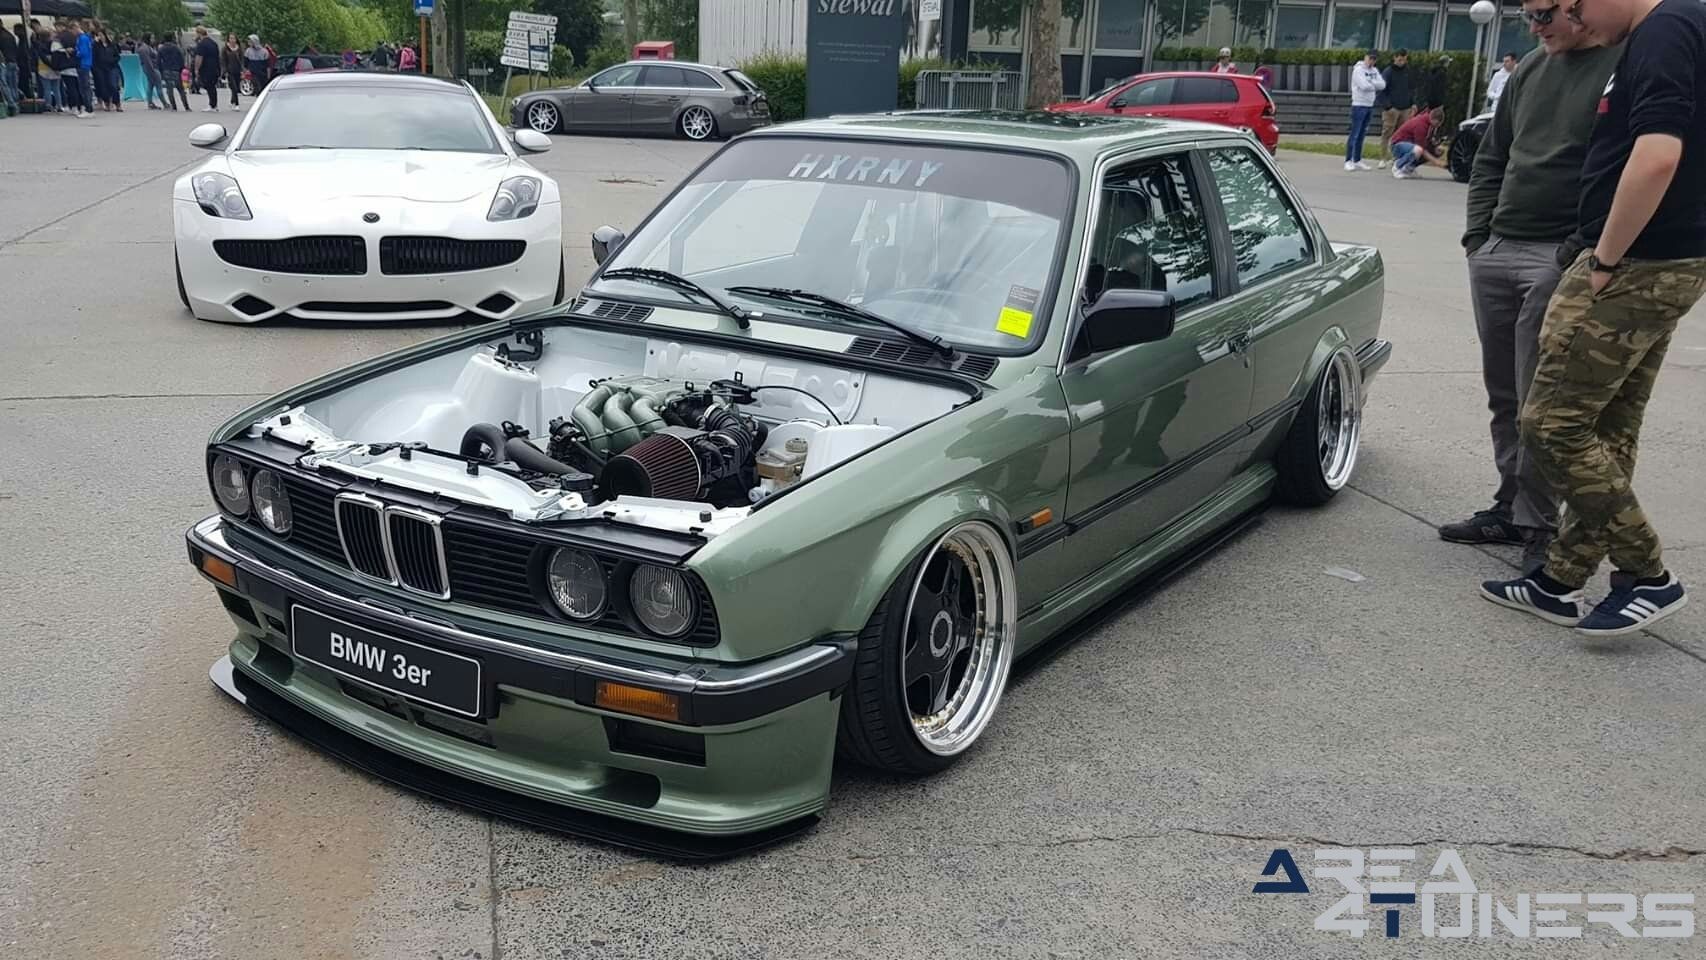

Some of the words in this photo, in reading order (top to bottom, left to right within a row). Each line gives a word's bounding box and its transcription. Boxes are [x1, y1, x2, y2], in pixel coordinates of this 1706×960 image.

[788, 153, 944, 187] HXRNY
[330, 632, 386, 672] BMW
[392, 654, 431, 686] 3er
